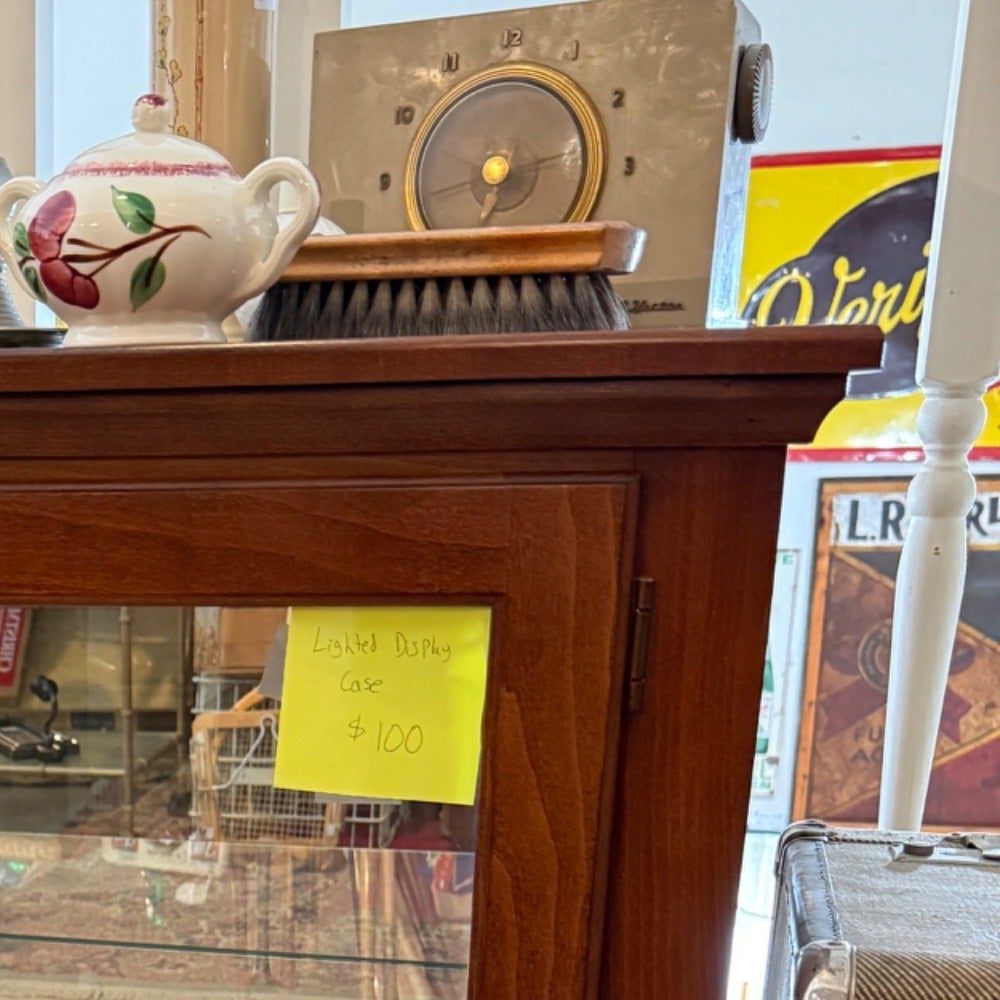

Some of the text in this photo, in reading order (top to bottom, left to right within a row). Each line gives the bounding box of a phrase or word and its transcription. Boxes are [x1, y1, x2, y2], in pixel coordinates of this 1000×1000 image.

[502, 29, 522, 49] 12
[442, 52, 460, 72] 11
[612, 89, 626, 108] 2
[394, 105, 415, 125] 10
[624, 156, 636, 176] 3
[379, 172, 392, 192] 9
[312, 625, 452, 663] Lighted Display
[340, 670, 384, 694] Case
